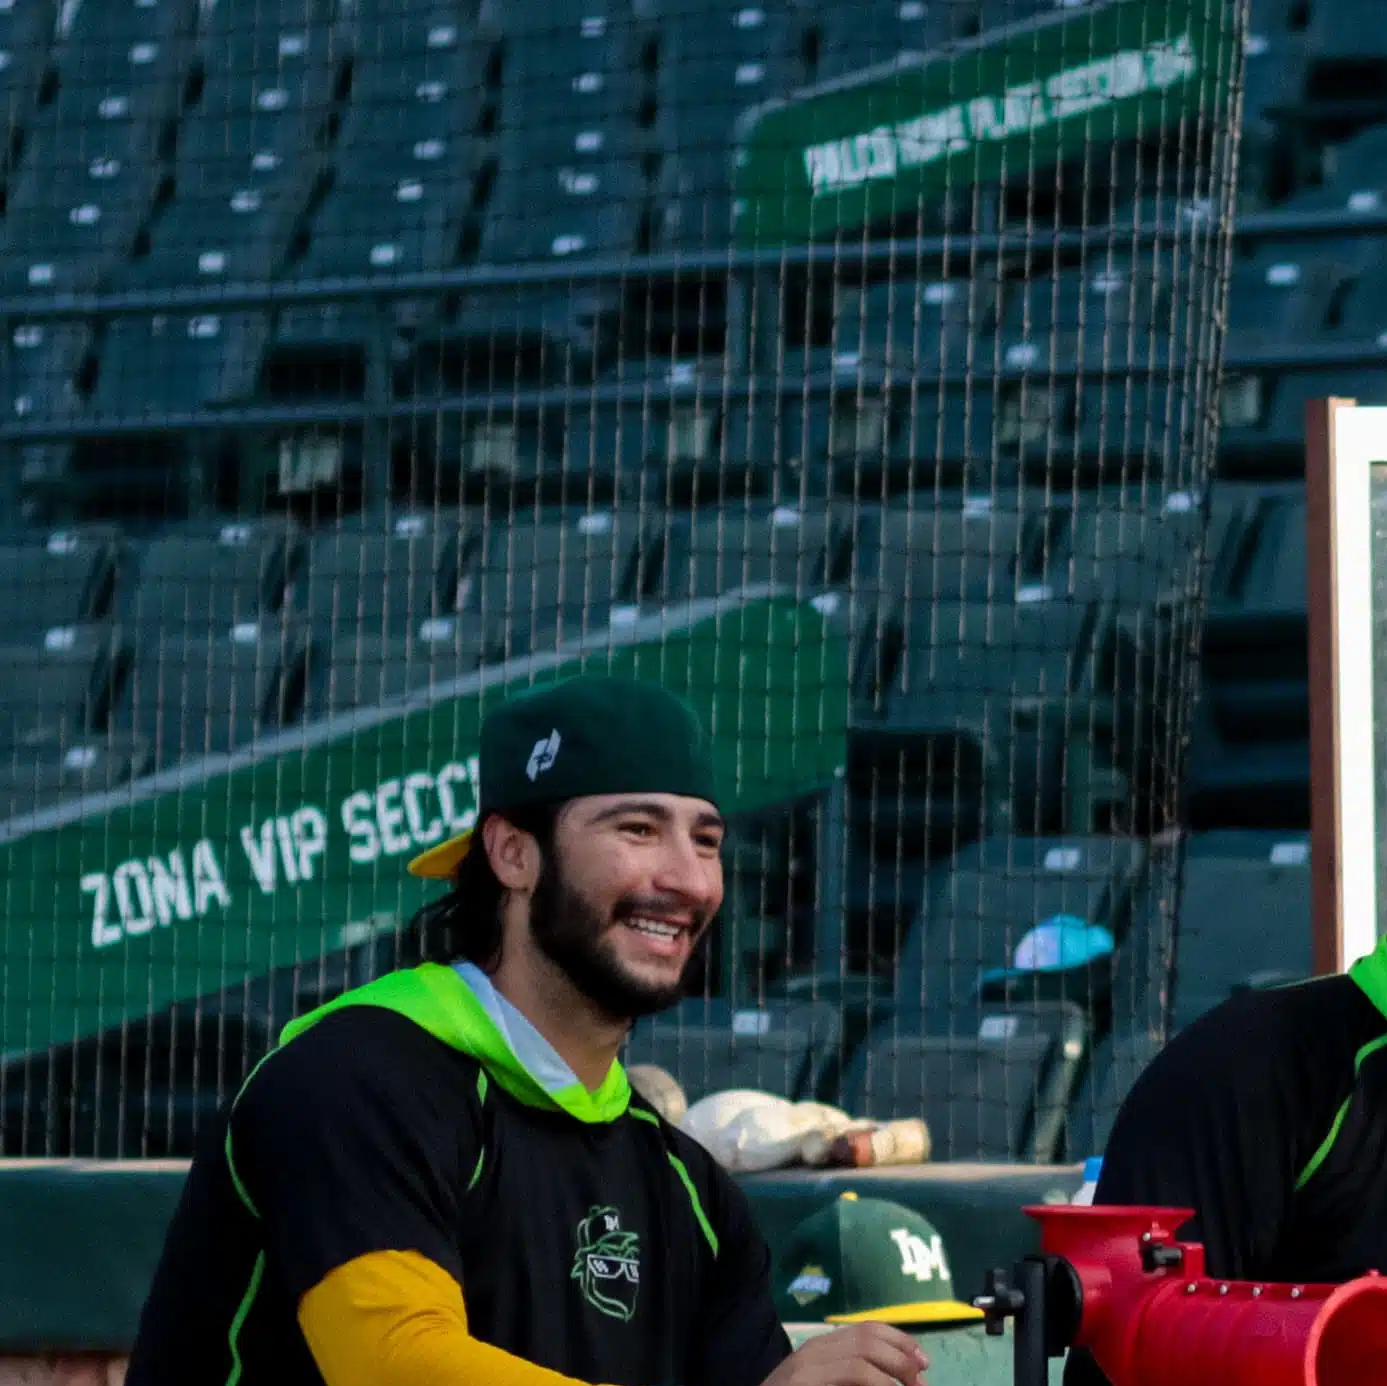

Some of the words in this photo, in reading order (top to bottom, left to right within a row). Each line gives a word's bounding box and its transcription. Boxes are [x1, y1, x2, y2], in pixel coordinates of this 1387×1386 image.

[80, 838, 231, 948] ZONA
[240, 806, 327, 895] VIP
[889, 1228, 951, 1282] LM
